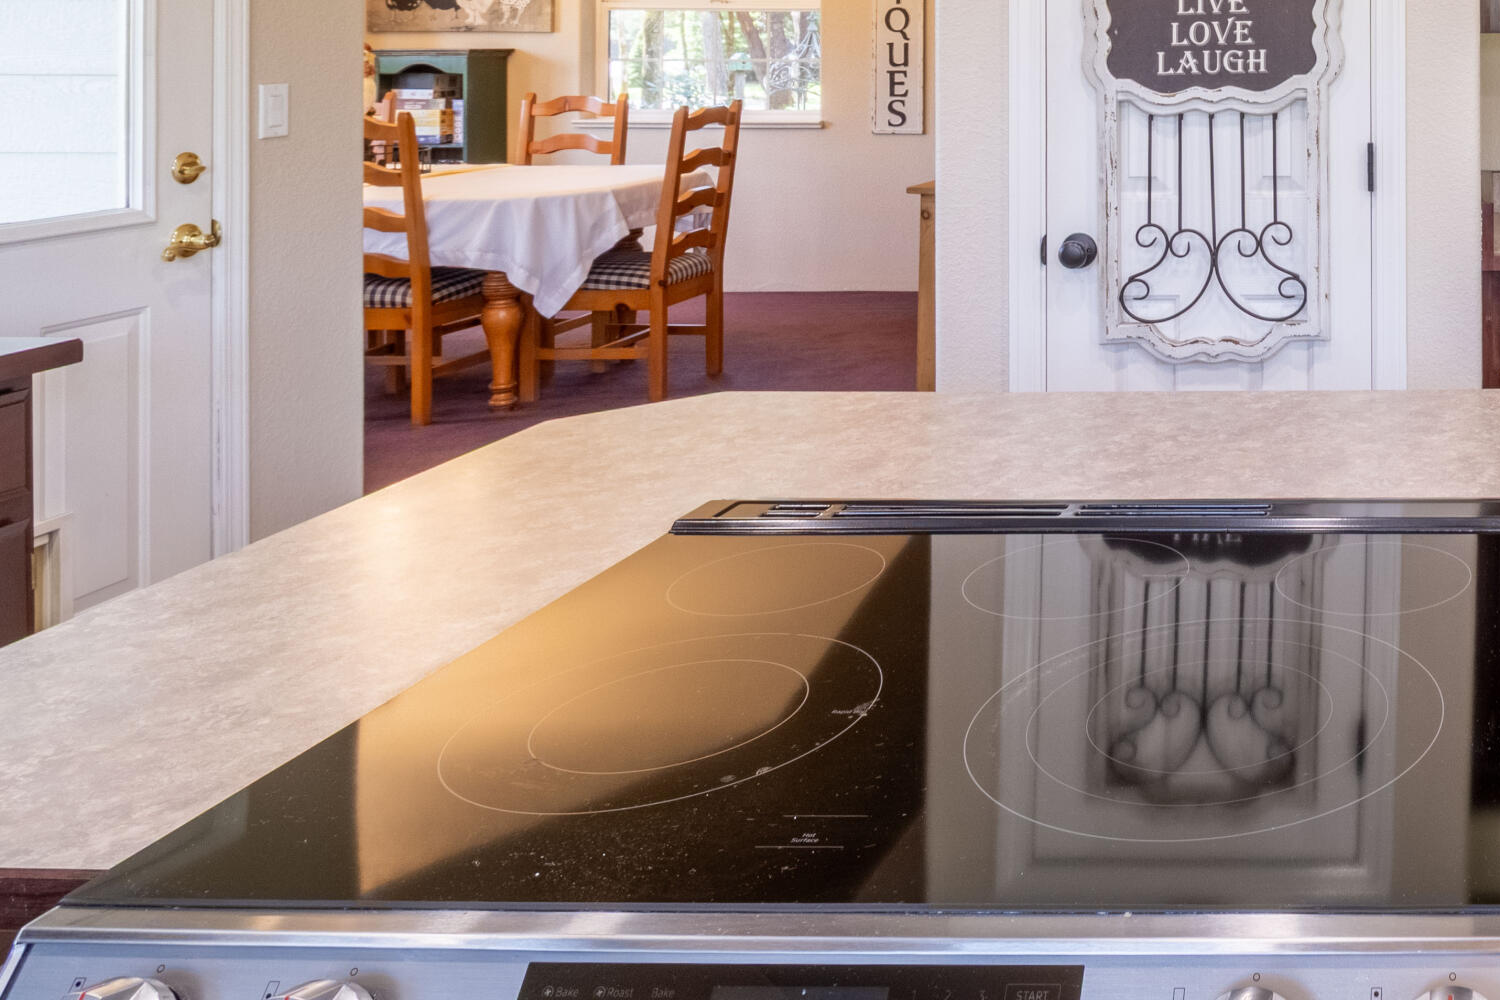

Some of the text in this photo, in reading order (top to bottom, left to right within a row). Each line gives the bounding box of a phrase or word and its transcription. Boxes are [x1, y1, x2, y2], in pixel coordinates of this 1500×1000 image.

[1171, 16, 1255, 47] LOVE
[1156, 48, 1268, 76] LAUGH
[555, 986, 579, 998] Bake
[1016, 990, 1050, 1000] START
